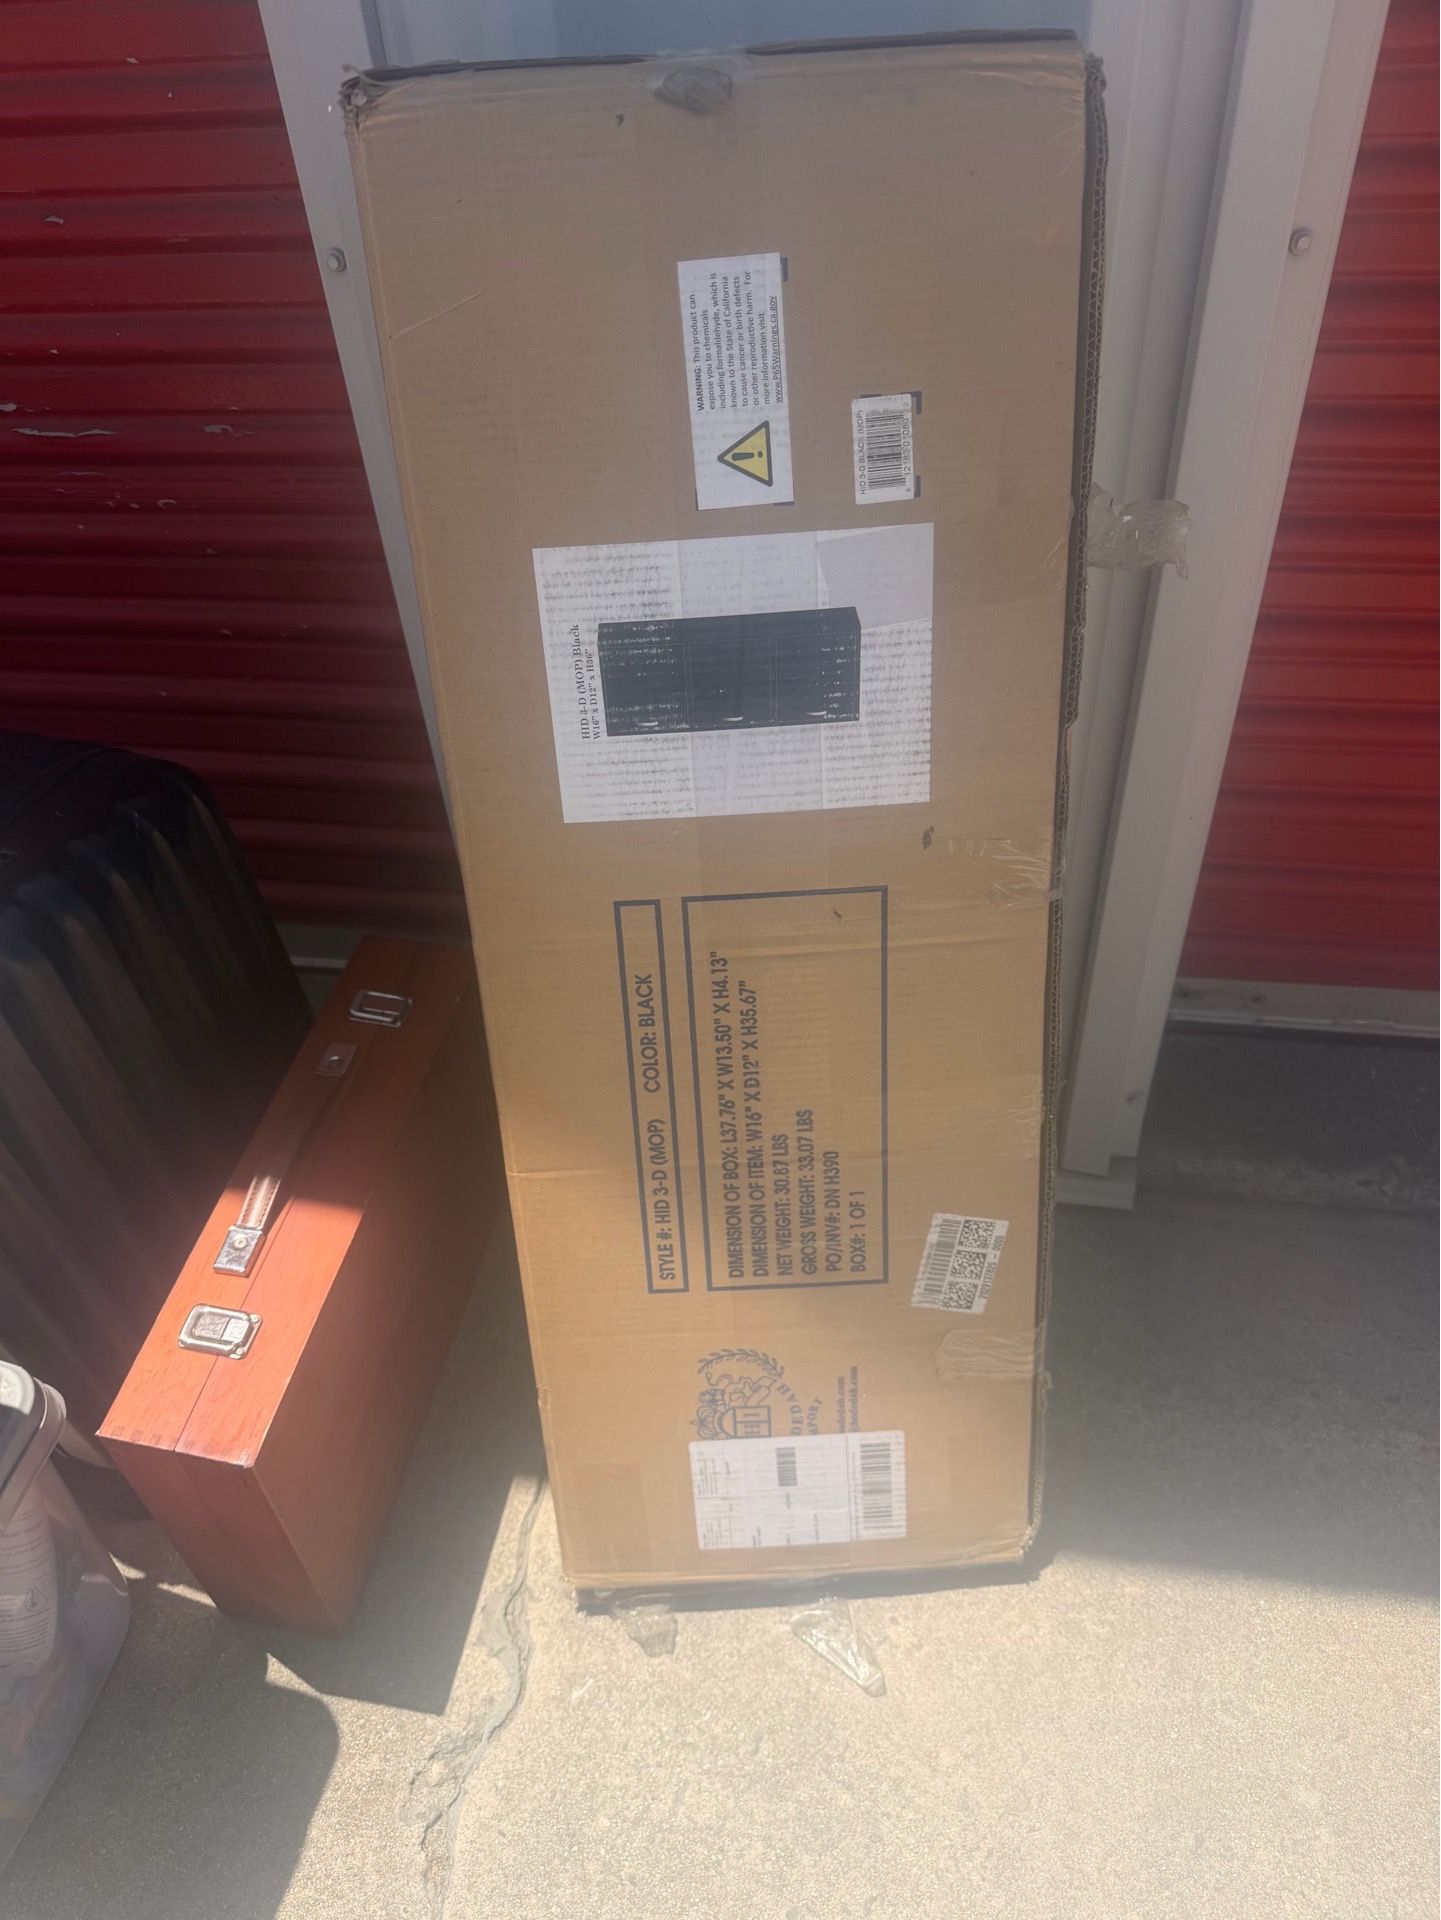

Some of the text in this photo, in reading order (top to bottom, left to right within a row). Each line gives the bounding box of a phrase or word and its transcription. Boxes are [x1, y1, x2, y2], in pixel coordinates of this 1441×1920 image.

[711, 281, 720, 307] which
[743, 271, 752, 285] For
[690, 312, 701, 344] product
[713, 309, 724, 370] formaldehyde,
[721, 276, 738, 408] known to the State of California
[732, 276, 749, 406] to cause cancer or birth defects
[745, 317, 757, 370] reproductive
[693, 346, 701, 363] This
[701, 310, 716, 410] expose you to chemicals
[758, 313, 770, 404] more information visit
[768, 296, 783, 403] www.P65Warnings.ca.gov
[695, 365, 704, 411] WARNING:
[717, 371, 726, 409] including
[750, 372, 759, 395] other
[752, 397, 760, 406] or
[571, 624, 590, 739] HID 3-D (MOP) Black
[713, 1003, 730, 1014] X
[741, 1039, 758, 1050] X
[717, 1079, 734, 1090] X
[744, 1092, 761, 1102] X
[635, 974, 676, 1280] STYLE #: HID 3-D (MOP) COLOR: BLACK
[722, 1147, 739, 1179] BOX:
[748, 1145, 764, 1178] ITEM:
[724, 1183, 740, 1202] OF
[749, 1182, 765, 1201] OF
[772, 1134, 793, 1276] NET WEIGHT: 30.87 LBS
[797, 1109, 817, 1275] GROSS WEIGHT: 33.07 LBS
[849, 1200, 865, 1219] OF
[823, 1152, 843, 1272] PO/INV#: DN H390
[725, 1205, 744, 1278] DIMENSION
[750, 1204, 769, 1277] DIMENSION
[851, 1233, 866, 1272] BOX#:
[776, 1383, 803, 1435] DEDAH
